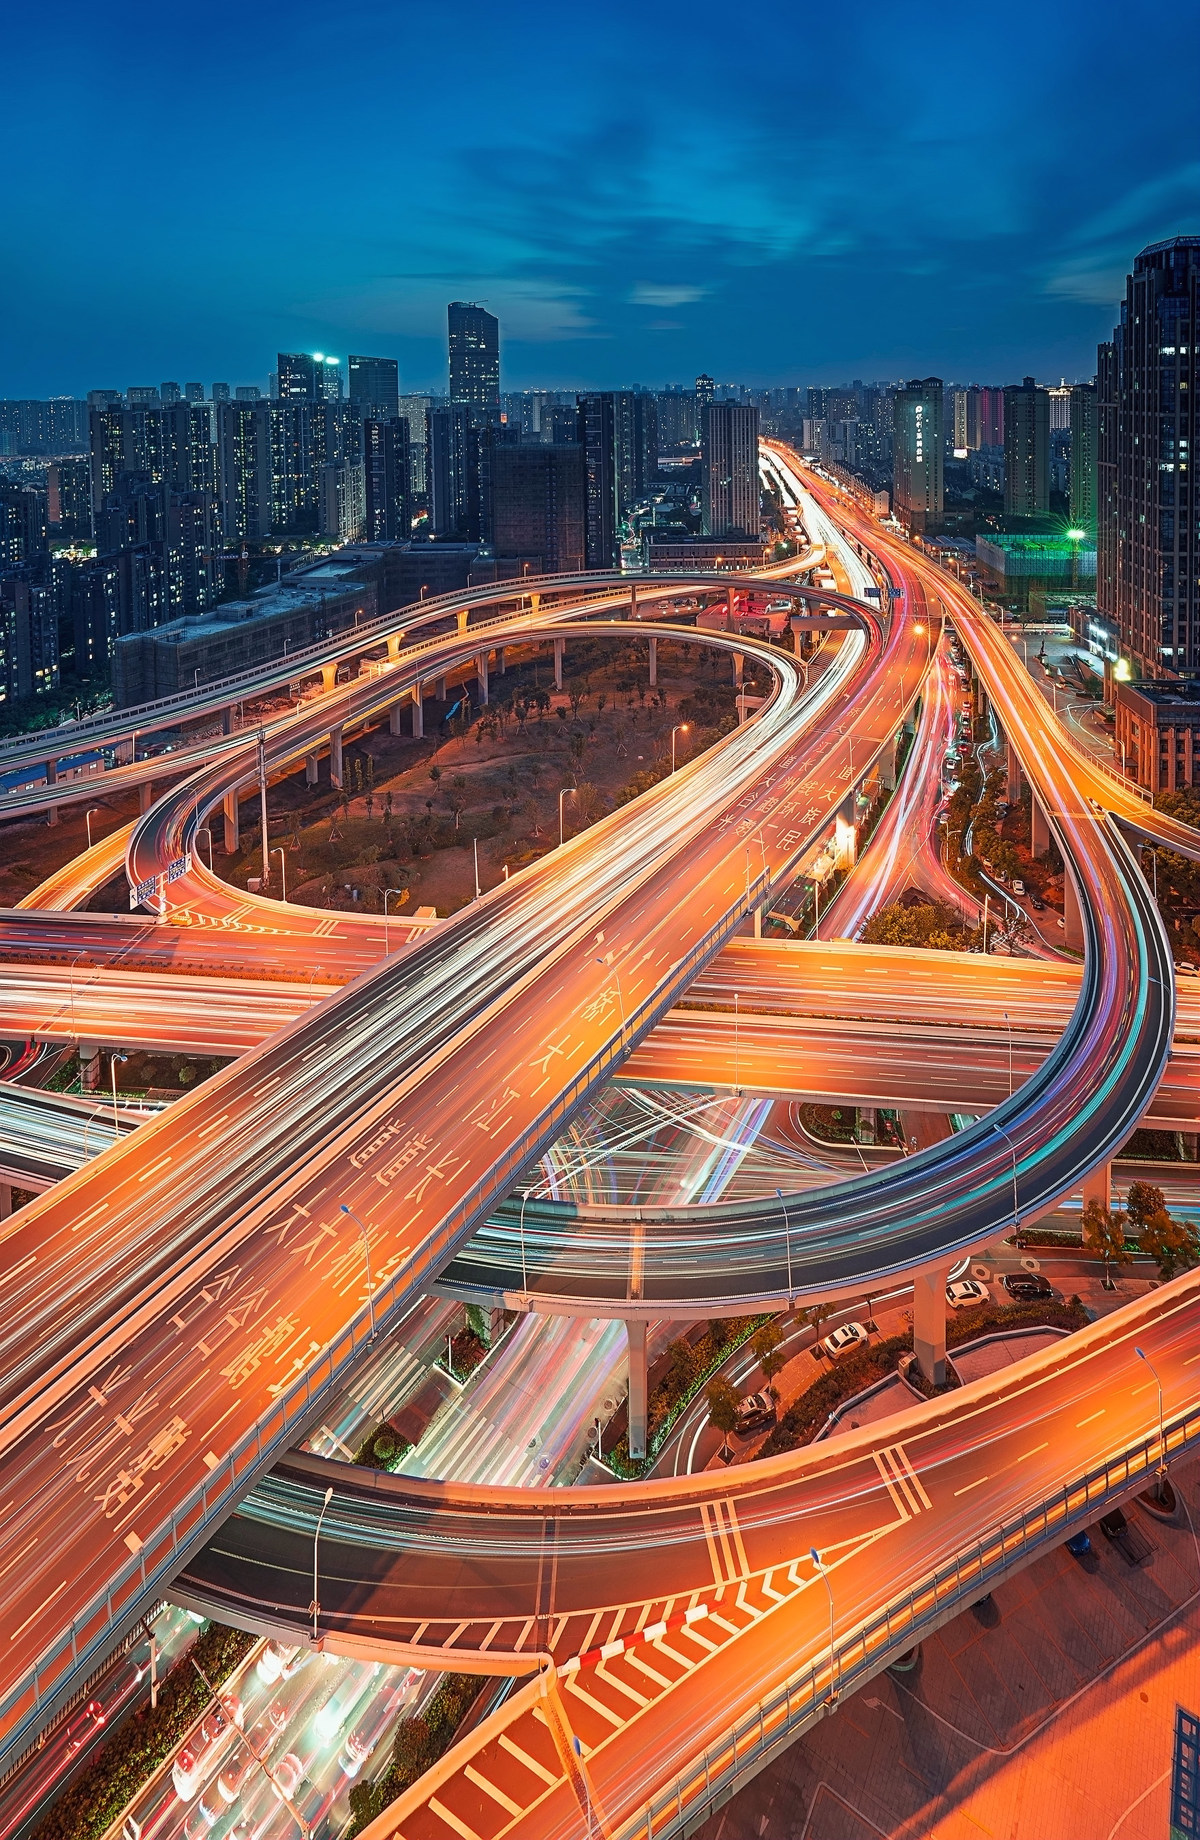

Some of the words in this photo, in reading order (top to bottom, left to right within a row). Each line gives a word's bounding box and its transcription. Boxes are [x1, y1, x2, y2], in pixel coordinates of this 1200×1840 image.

[710, 754, 798, 832] 光谷大道
[733, 706, 863, 838] 鹦鹉洲长江大桥
[751, 778, 822, 844] 二环线
[775, 764, 857, 851] 民族大道
[45, 1116, 406, 1448] 光谷大道
[66, 1132, 434, 1483] 光谷大道
[93, 985, 623, 1519] 鹦鹉洲长江大桥
